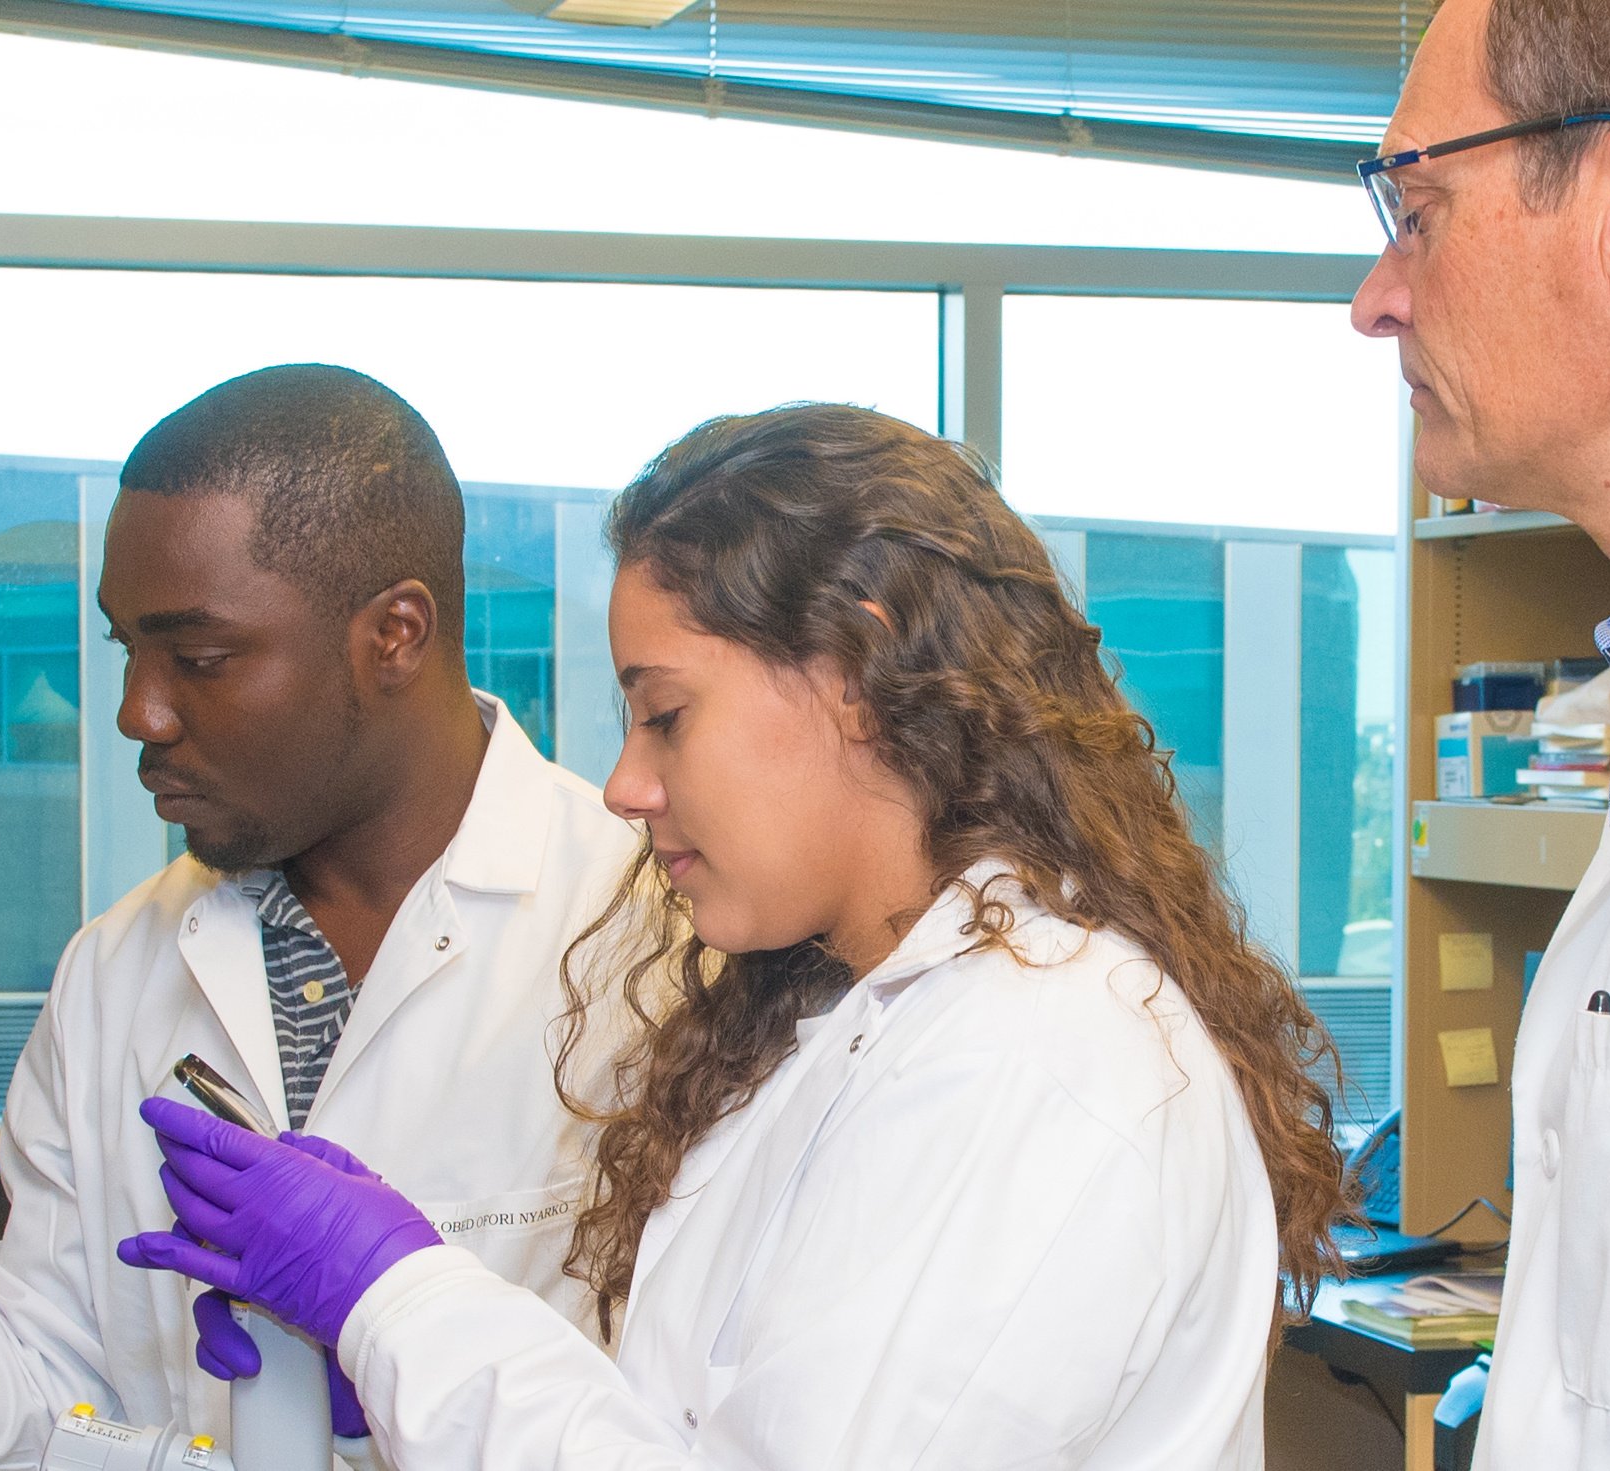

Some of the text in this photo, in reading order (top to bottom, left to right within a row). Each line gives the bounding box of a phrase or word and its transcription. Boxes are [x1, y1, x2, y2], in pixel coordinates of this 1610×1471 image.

[440, 1218, 475, 1234] OBED
[476, 1213, 515, 1229] OFORI
[519, 1202, 569, 1225] NYARKO
